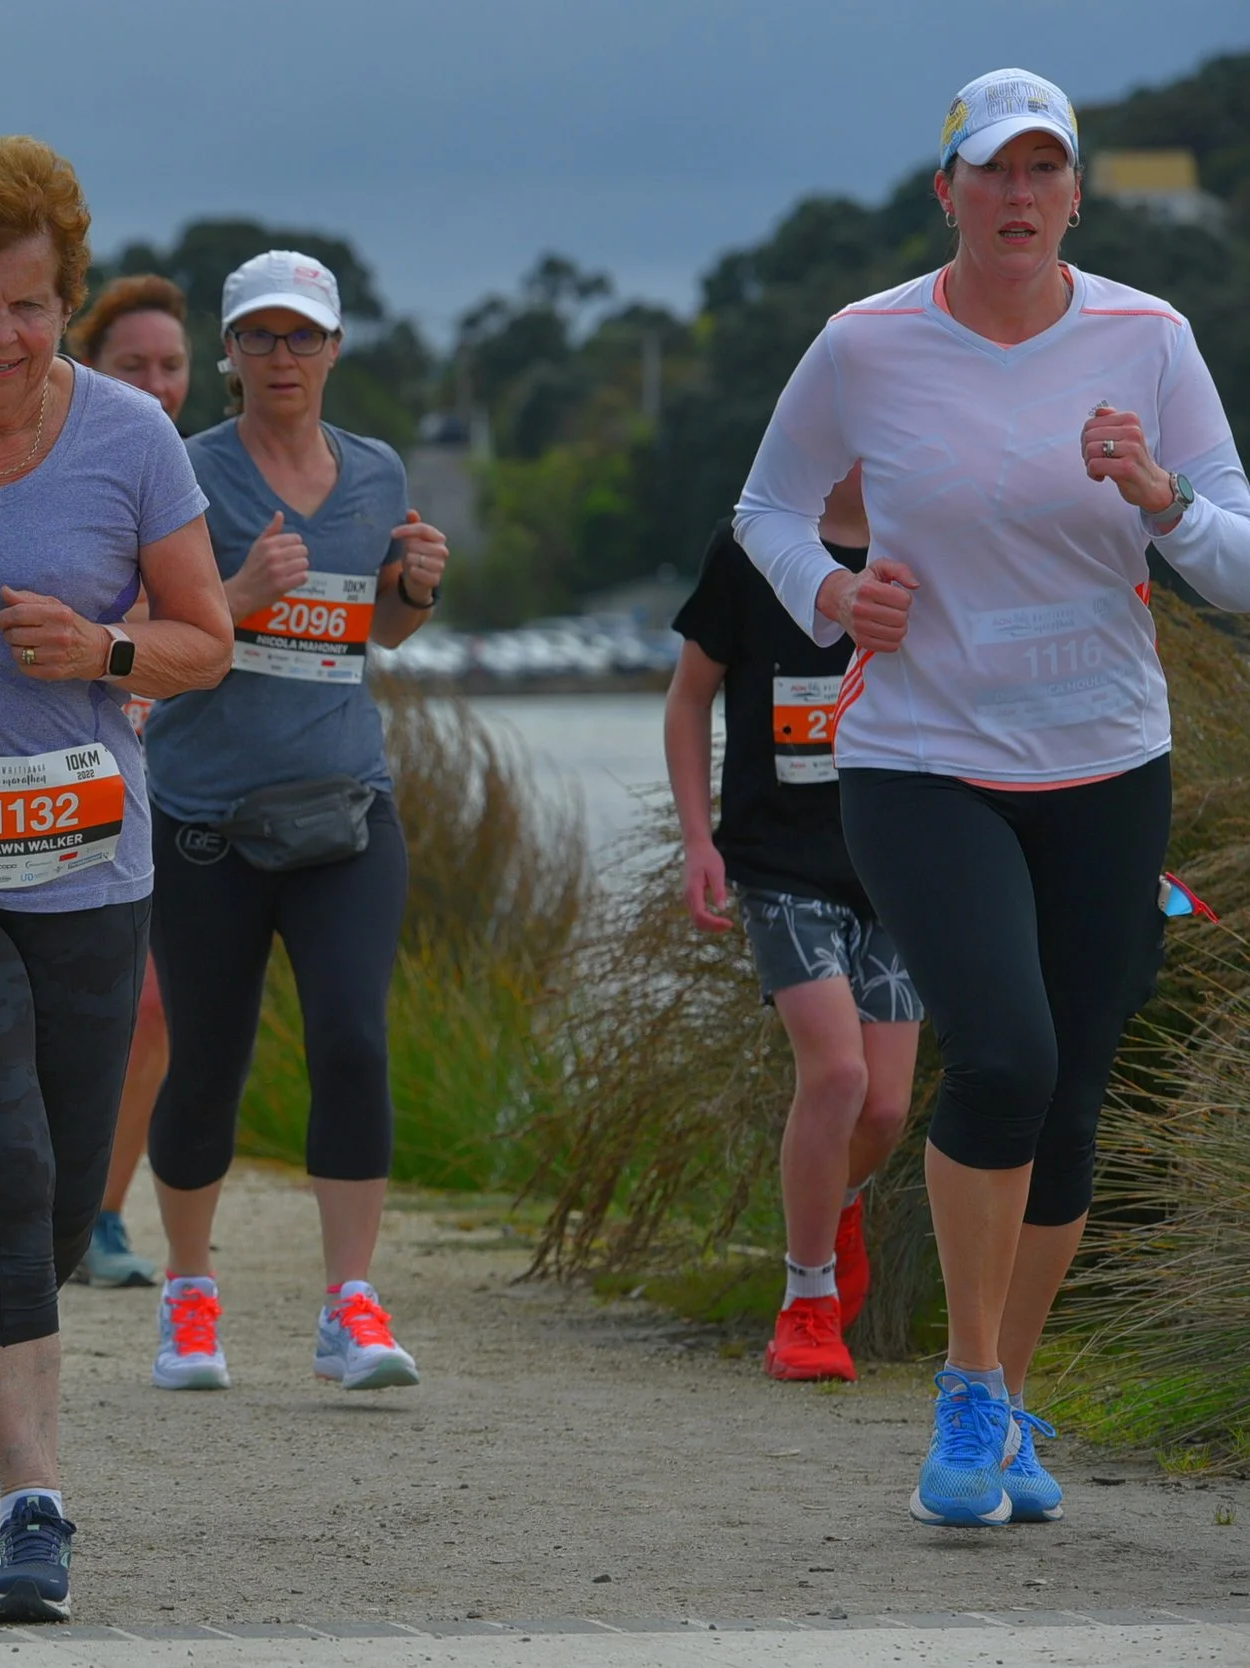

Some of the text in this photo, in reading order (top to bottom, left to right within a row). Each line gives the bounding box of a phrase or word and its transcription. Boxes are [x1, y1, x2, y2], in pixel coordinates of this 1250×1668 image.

[985, 81, 1020, 103] RUN
[987, 97, 1026, 117] CITY
[267, 601, 347, 637] 2096
[256, 634, 349, 654] NICOLA MAHONEY
[1023, 634, 1102, 678] 1116
[65, 750, 100, 771] 10KM
[77, 769, 95, 780] 2022
[28, 833, 83, 852] WALKER
